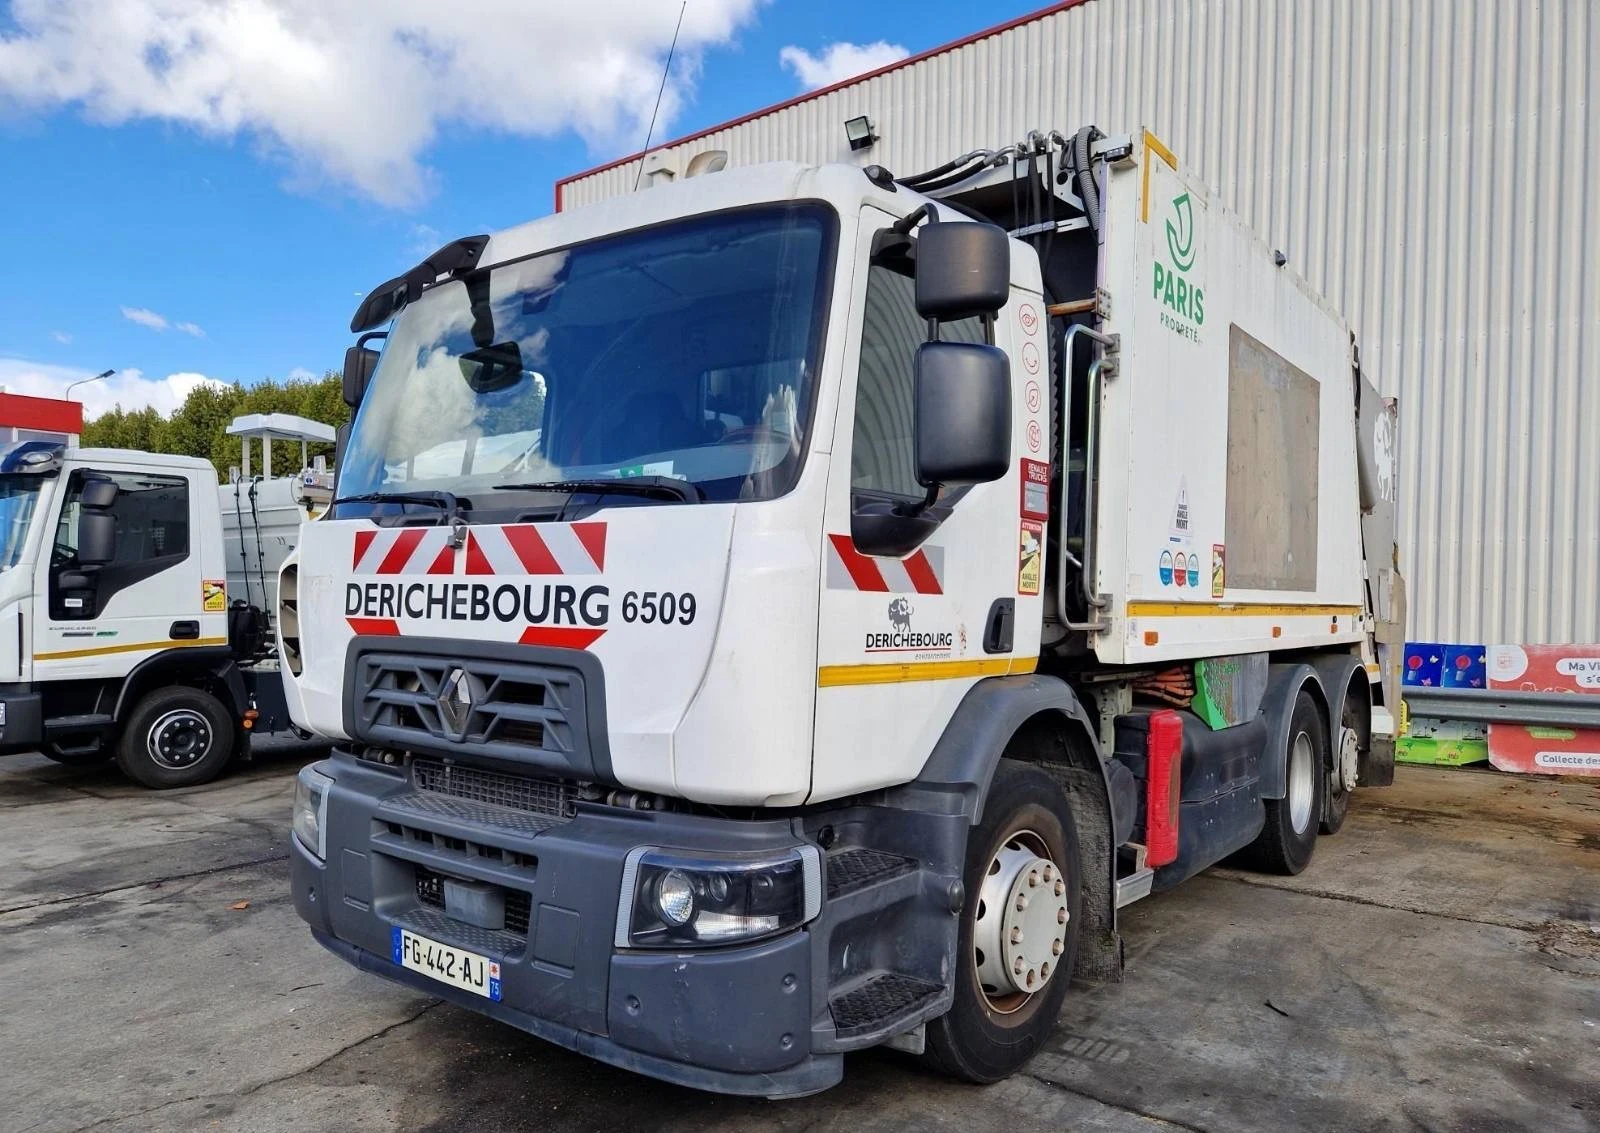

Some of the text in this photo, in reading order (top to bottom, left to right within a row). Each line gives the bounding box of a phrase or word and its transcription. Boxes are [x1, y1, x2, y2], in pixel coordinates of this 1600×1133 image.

[1153, 261, 1204, 326] PARIS
[345, 582, 697, 627] DERICHEBOURG 6509
[866, 633, 952, 648] DERICHEBOURG
[1568, 662, 1585, 671] Ma
[1542, 755, 1583, 764] Collecte
[403, 935, 484, 988] FG-442-AJ
[490, 980, 499, 996] 75
